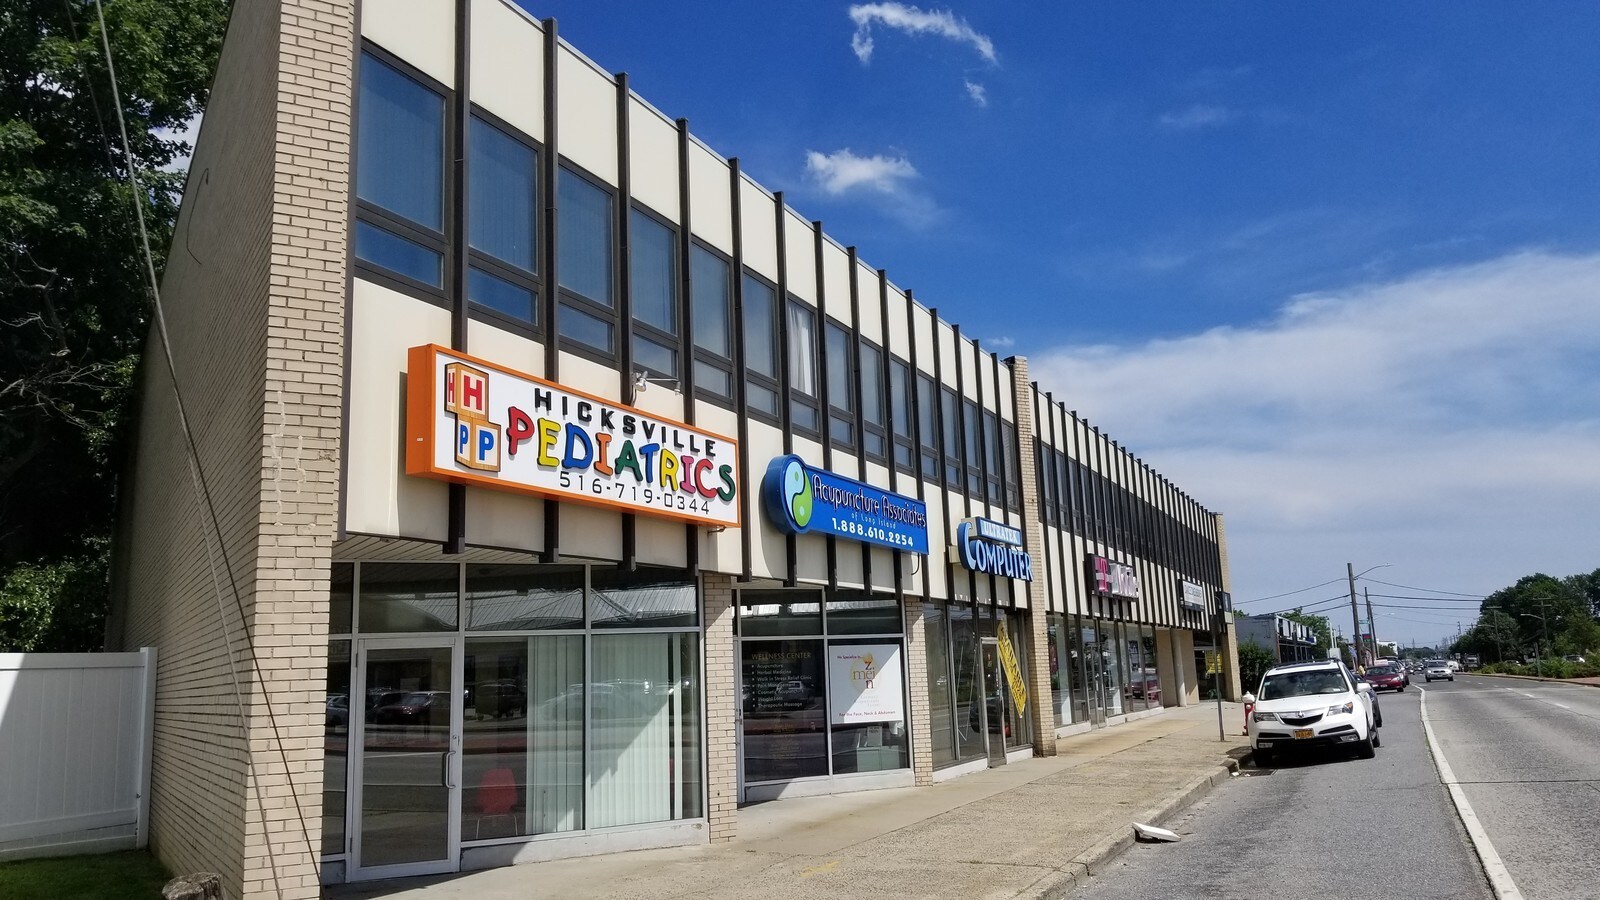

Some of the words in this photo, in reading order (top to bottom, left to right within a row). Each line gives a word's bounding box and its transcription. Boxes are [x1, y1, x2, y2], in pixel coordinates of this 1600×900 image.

[463, 376, 482, 411] H
[534, 387, 716, 457] HICKSVILLE
[479, 430, 494, 461] P
[506, 406, 736, 502] PEDIATRICS
[559, 471, 710, 515] 516-719-0344
[812, 473, 880, 514] Acupuncture
[881, 495, 926, 528] Associates
[832, 518, 914, 547] 1.888.610.2254
[851, 512, 858, 521] of
[861, 514, 875, 525] Long
[878, 518, 896, 530] Island
[959, 522, 1033, 582] COMPUTER
[751, 652, 785, 660] WELLNESS
[786, 651, 812, 659] CENTER
